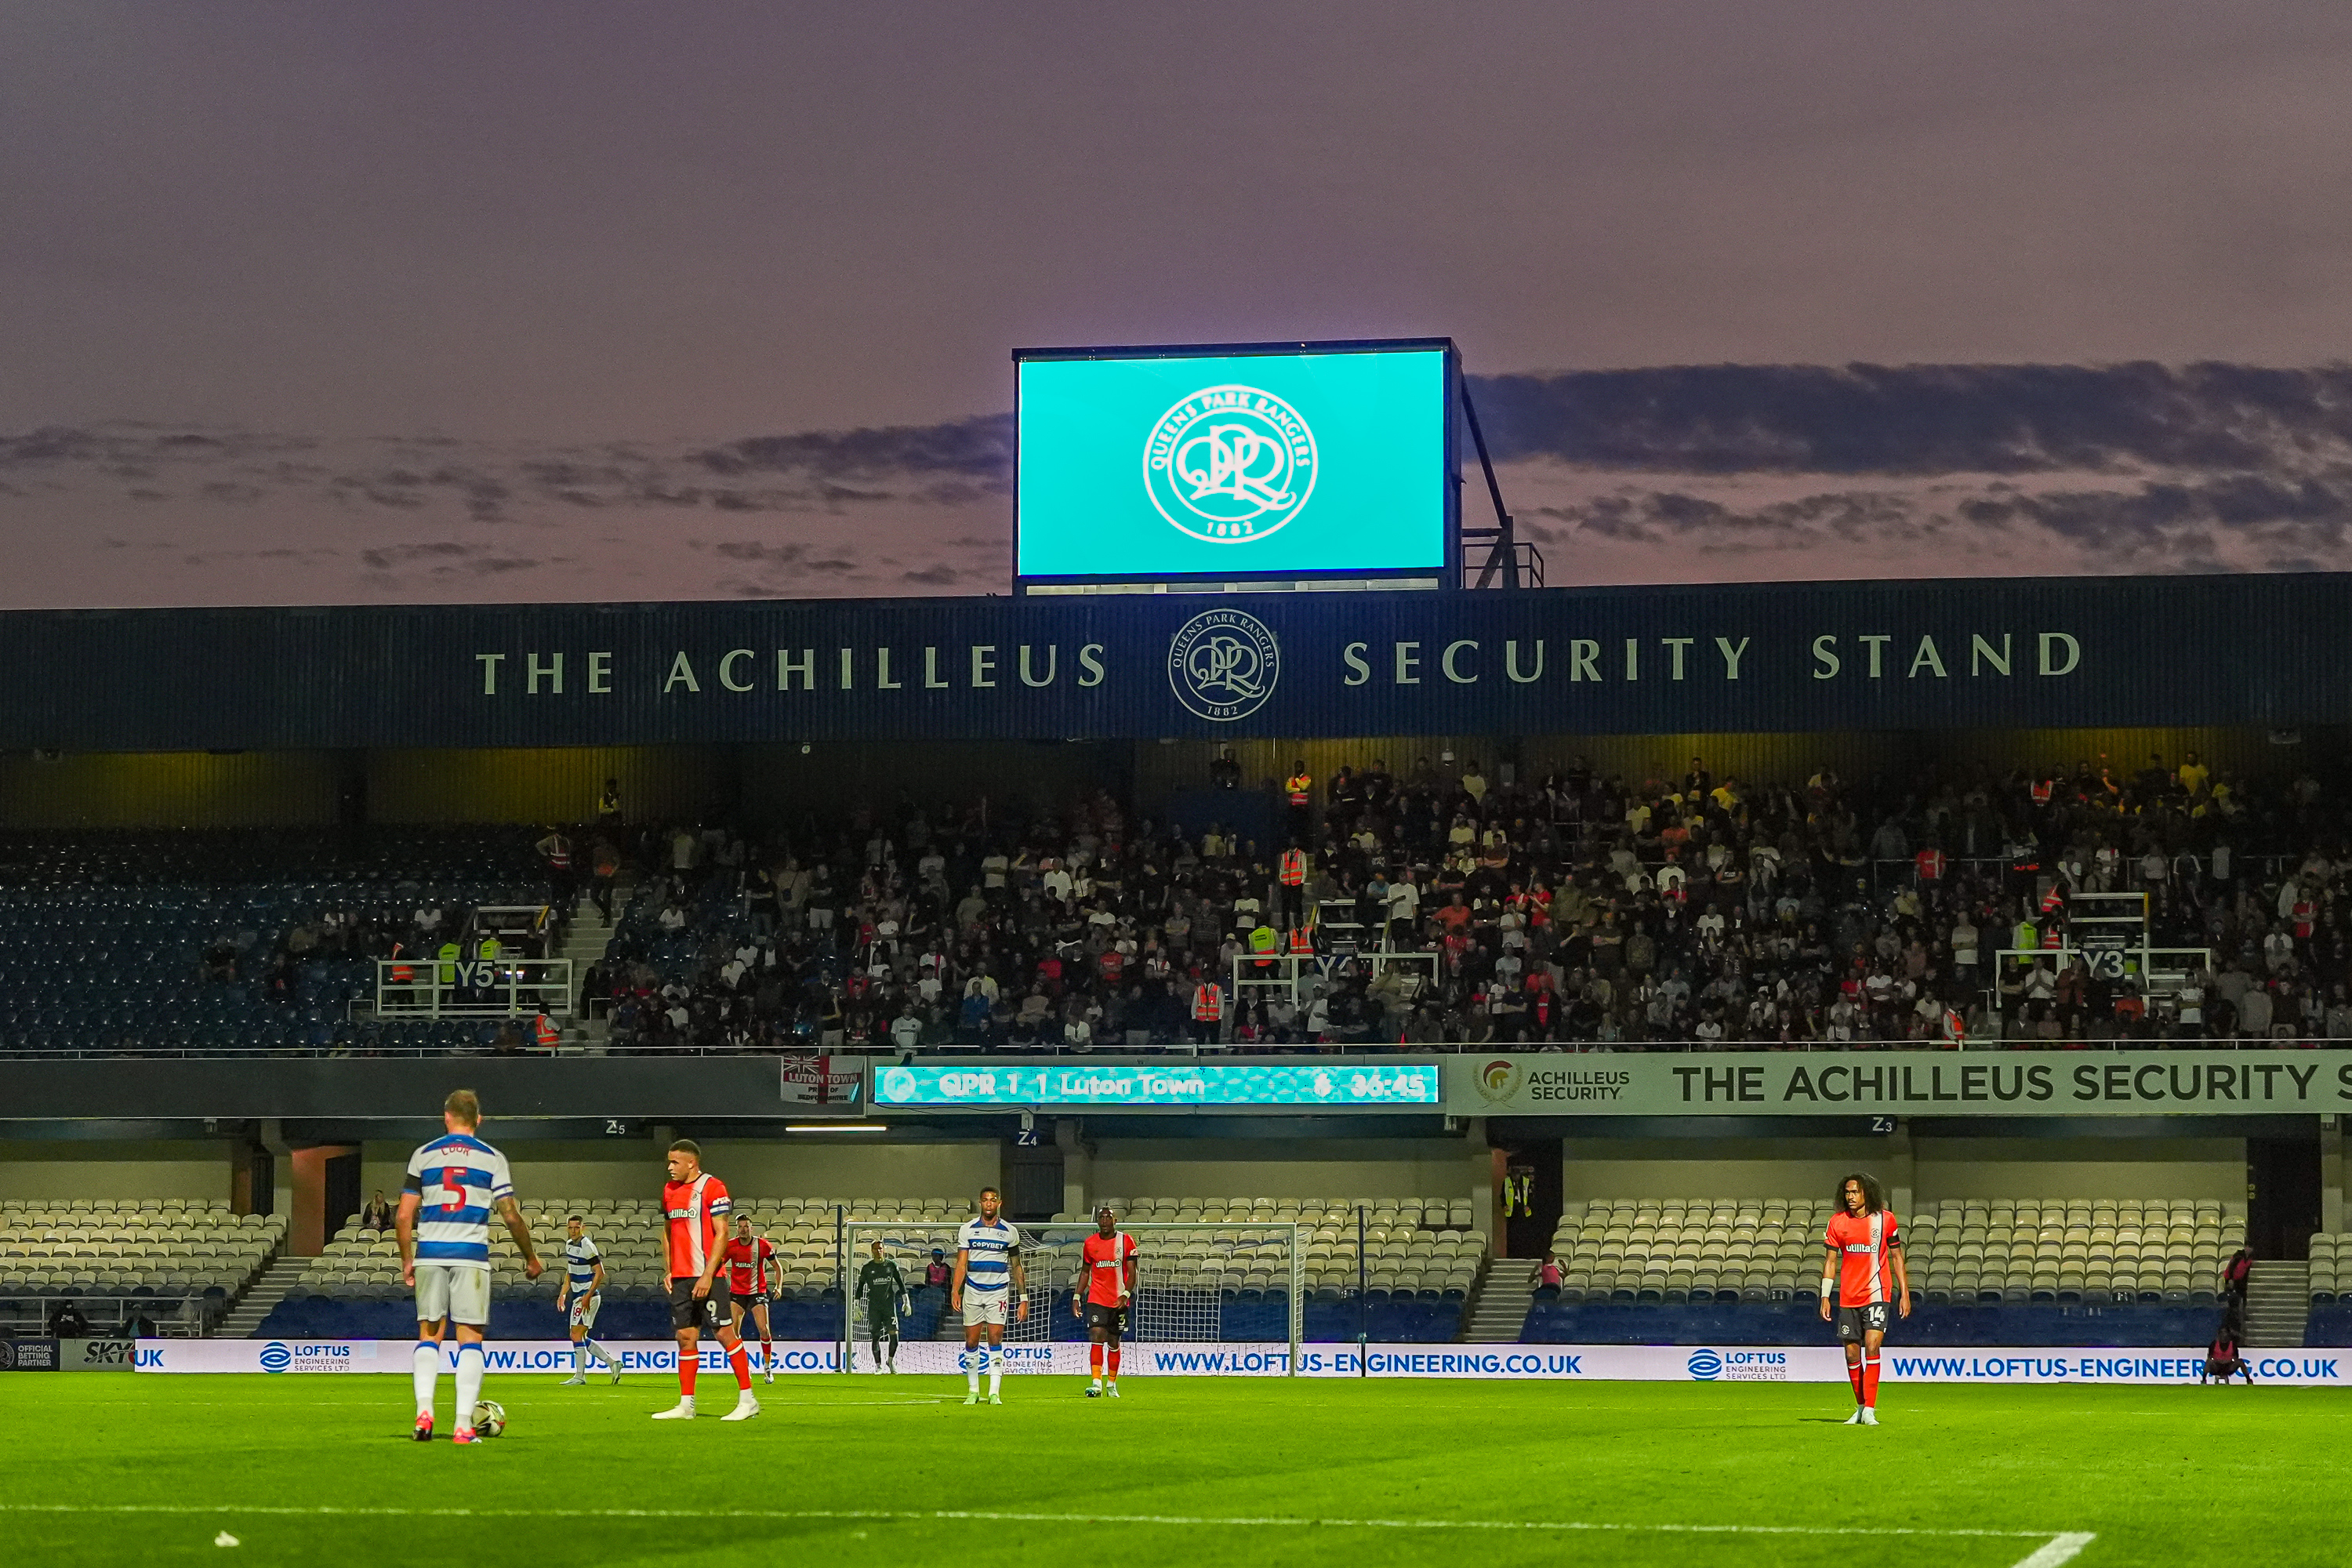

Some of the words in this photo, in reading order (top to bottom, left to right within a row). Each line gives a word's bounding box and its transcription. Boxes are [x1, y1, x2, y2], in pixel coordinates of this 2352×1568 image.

[1151, 403, 1198, 470] QUEENS
[1201, 392, 1250, 409] PARK
[1259, 396, 1311, 467] RANGERS
[1207, 521, 1254, 536] 1882
[1173, 622, 1203, 669] QUEENS
[1206, 613, 1236, 626] PARK
[1240, 618, 1275, 668] RANGERS
[476, 652, 612, 695] THE
[663, 644, 1105, 693] ACHILLEUS
[1343, 637, 1750, 686] SECURITY
[1813, 633, 2082, 679] STAND
[1207, 706, 1239, 717] 1882
[2082, 950, 2124, 978] Y3
[456, 961, 495, 988] Y5
[788, 1073, 824, 1083] LUTON
[826, 1073, 858, 1083] TOWN
[940, 1073, 996, 1096] QPR
[1007, 1073, 1018, 1094] 1
[1036, 1073, 1047, 1094] 1
[1060, 1073, 1132, 1095] Luton
[1137, 1073, 1205, 1095] Town
[1351, 1073, 1426, 1097] 36:45
[1528, 1071, 1630, 1085] ACHILLEUS
[1672, 1065, 1764, 1103] THE
[1784, 1064, 2054, 1102] ACHILLEUS
[2072, 1064, 2319, 1102] SECURITY
[1531, 1087, 1621, 1100] SECURITY
[606, 1120, 626, 1134] Z5
[1871, 1116, 1893, 1133] Z3
[1018, 1131, 1038, 1146] Z4
[441, 1166, 468, 1212] 5
[1846, 1243, 1871, 1253] utilita
[706, 1300, 717, 1317] 9
[1868, 1305, 1885, 1322] 14
[295, 1345, 350, 1356] LOFTUS
[1003, 1348, 1052, 1359] OFTUS
[1726, 1352, 1786, 1363] LOFTUS
